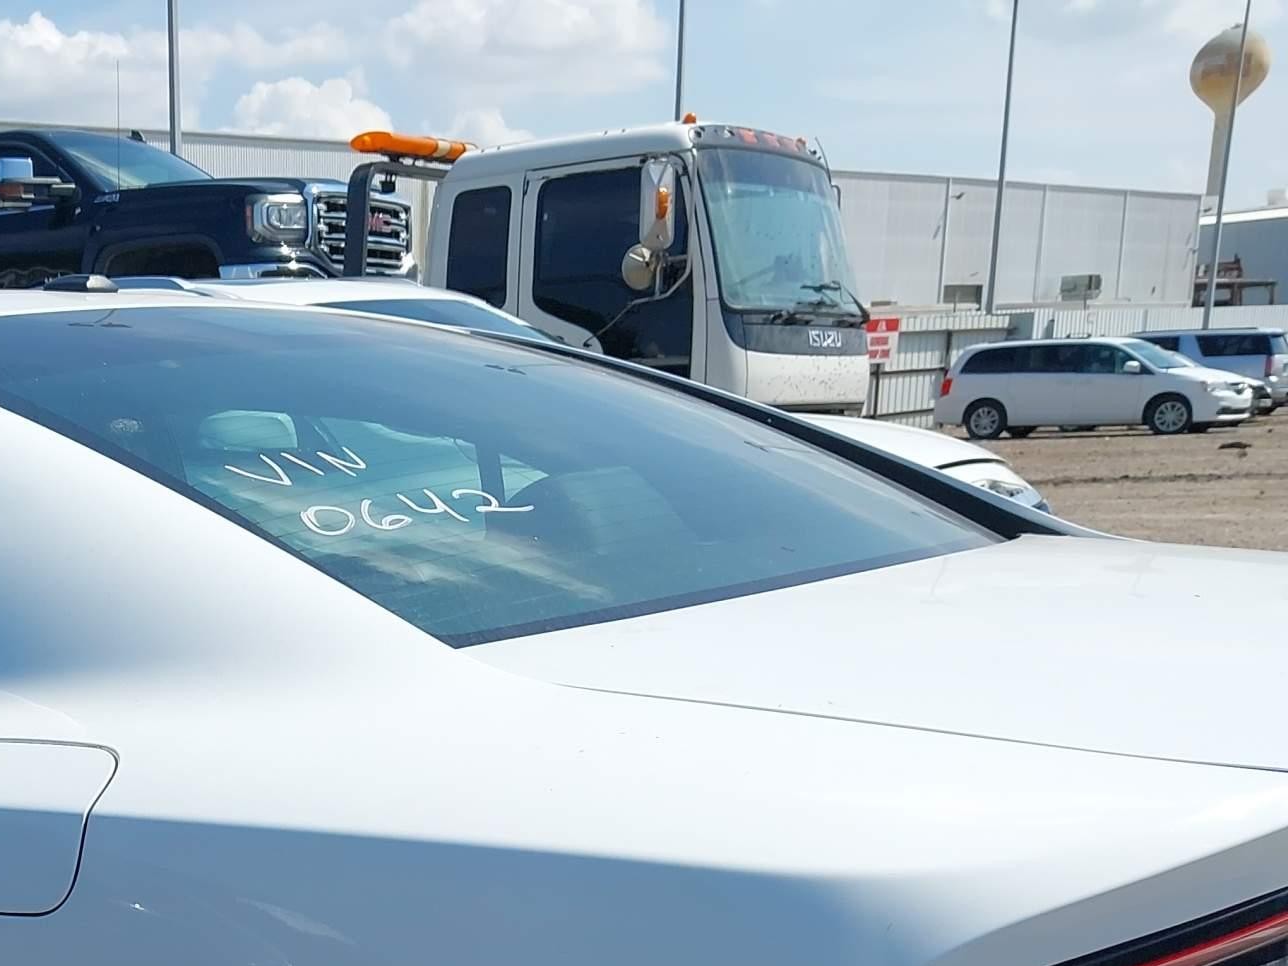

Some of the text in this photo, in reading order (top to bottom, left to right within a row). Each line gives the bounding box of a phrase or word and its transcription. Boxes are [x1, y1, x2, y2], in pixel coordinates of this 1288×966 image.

[367, 211, 392, 233] MC
[808, 329, 842, 348] ISUZU
[224, 446, 367, 486] VIN
[299, 488, 535, 536] 0642
